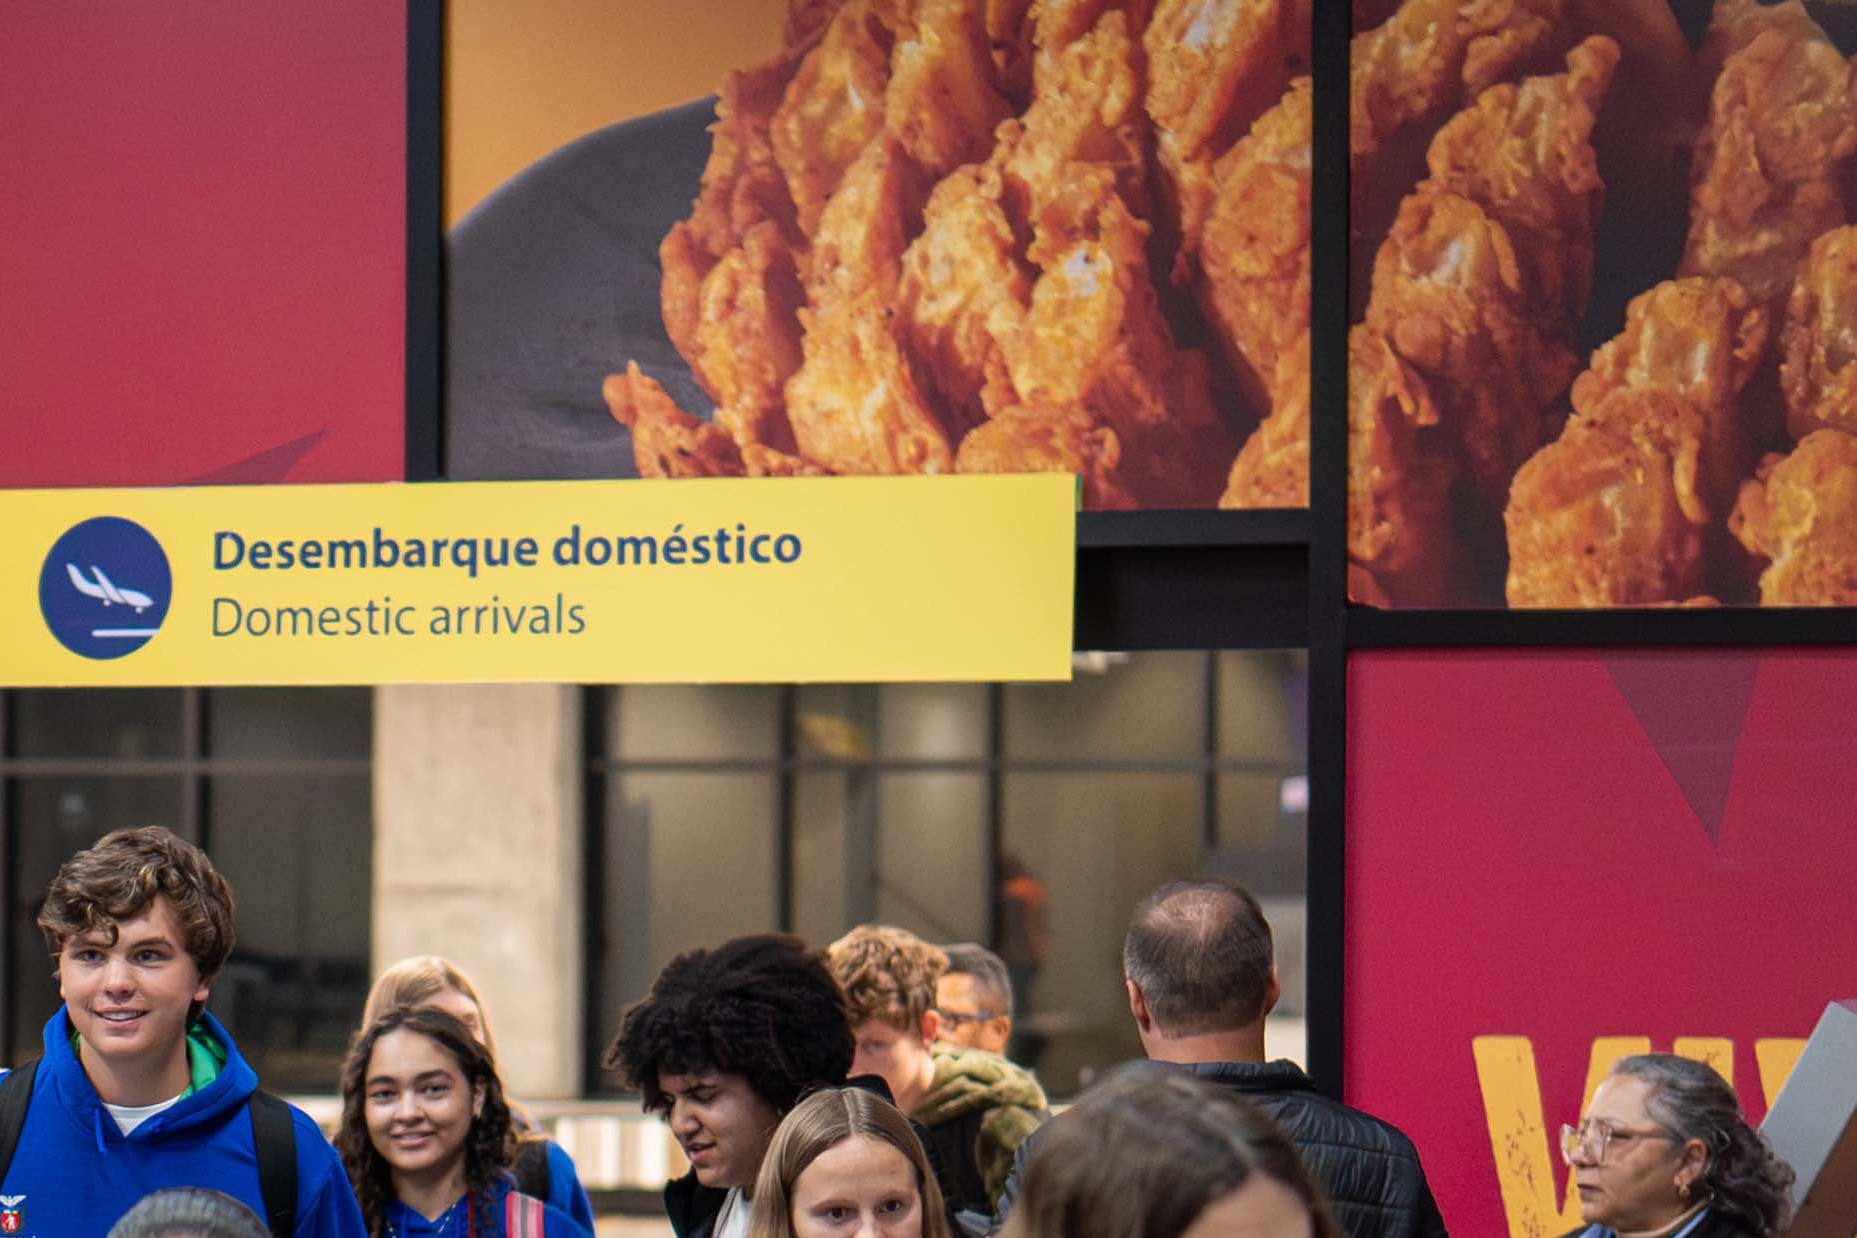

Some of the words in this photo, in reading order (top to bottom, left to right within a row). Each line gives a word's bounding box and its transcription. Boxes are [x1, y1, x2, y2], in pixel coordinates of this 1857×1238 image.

[213, 527, 539, 578] Desembarque
[552, 523, 802, 566] doméstico
[212, 596, 415, 637] Domestic
[429, 593, 586, 635] arrivals
